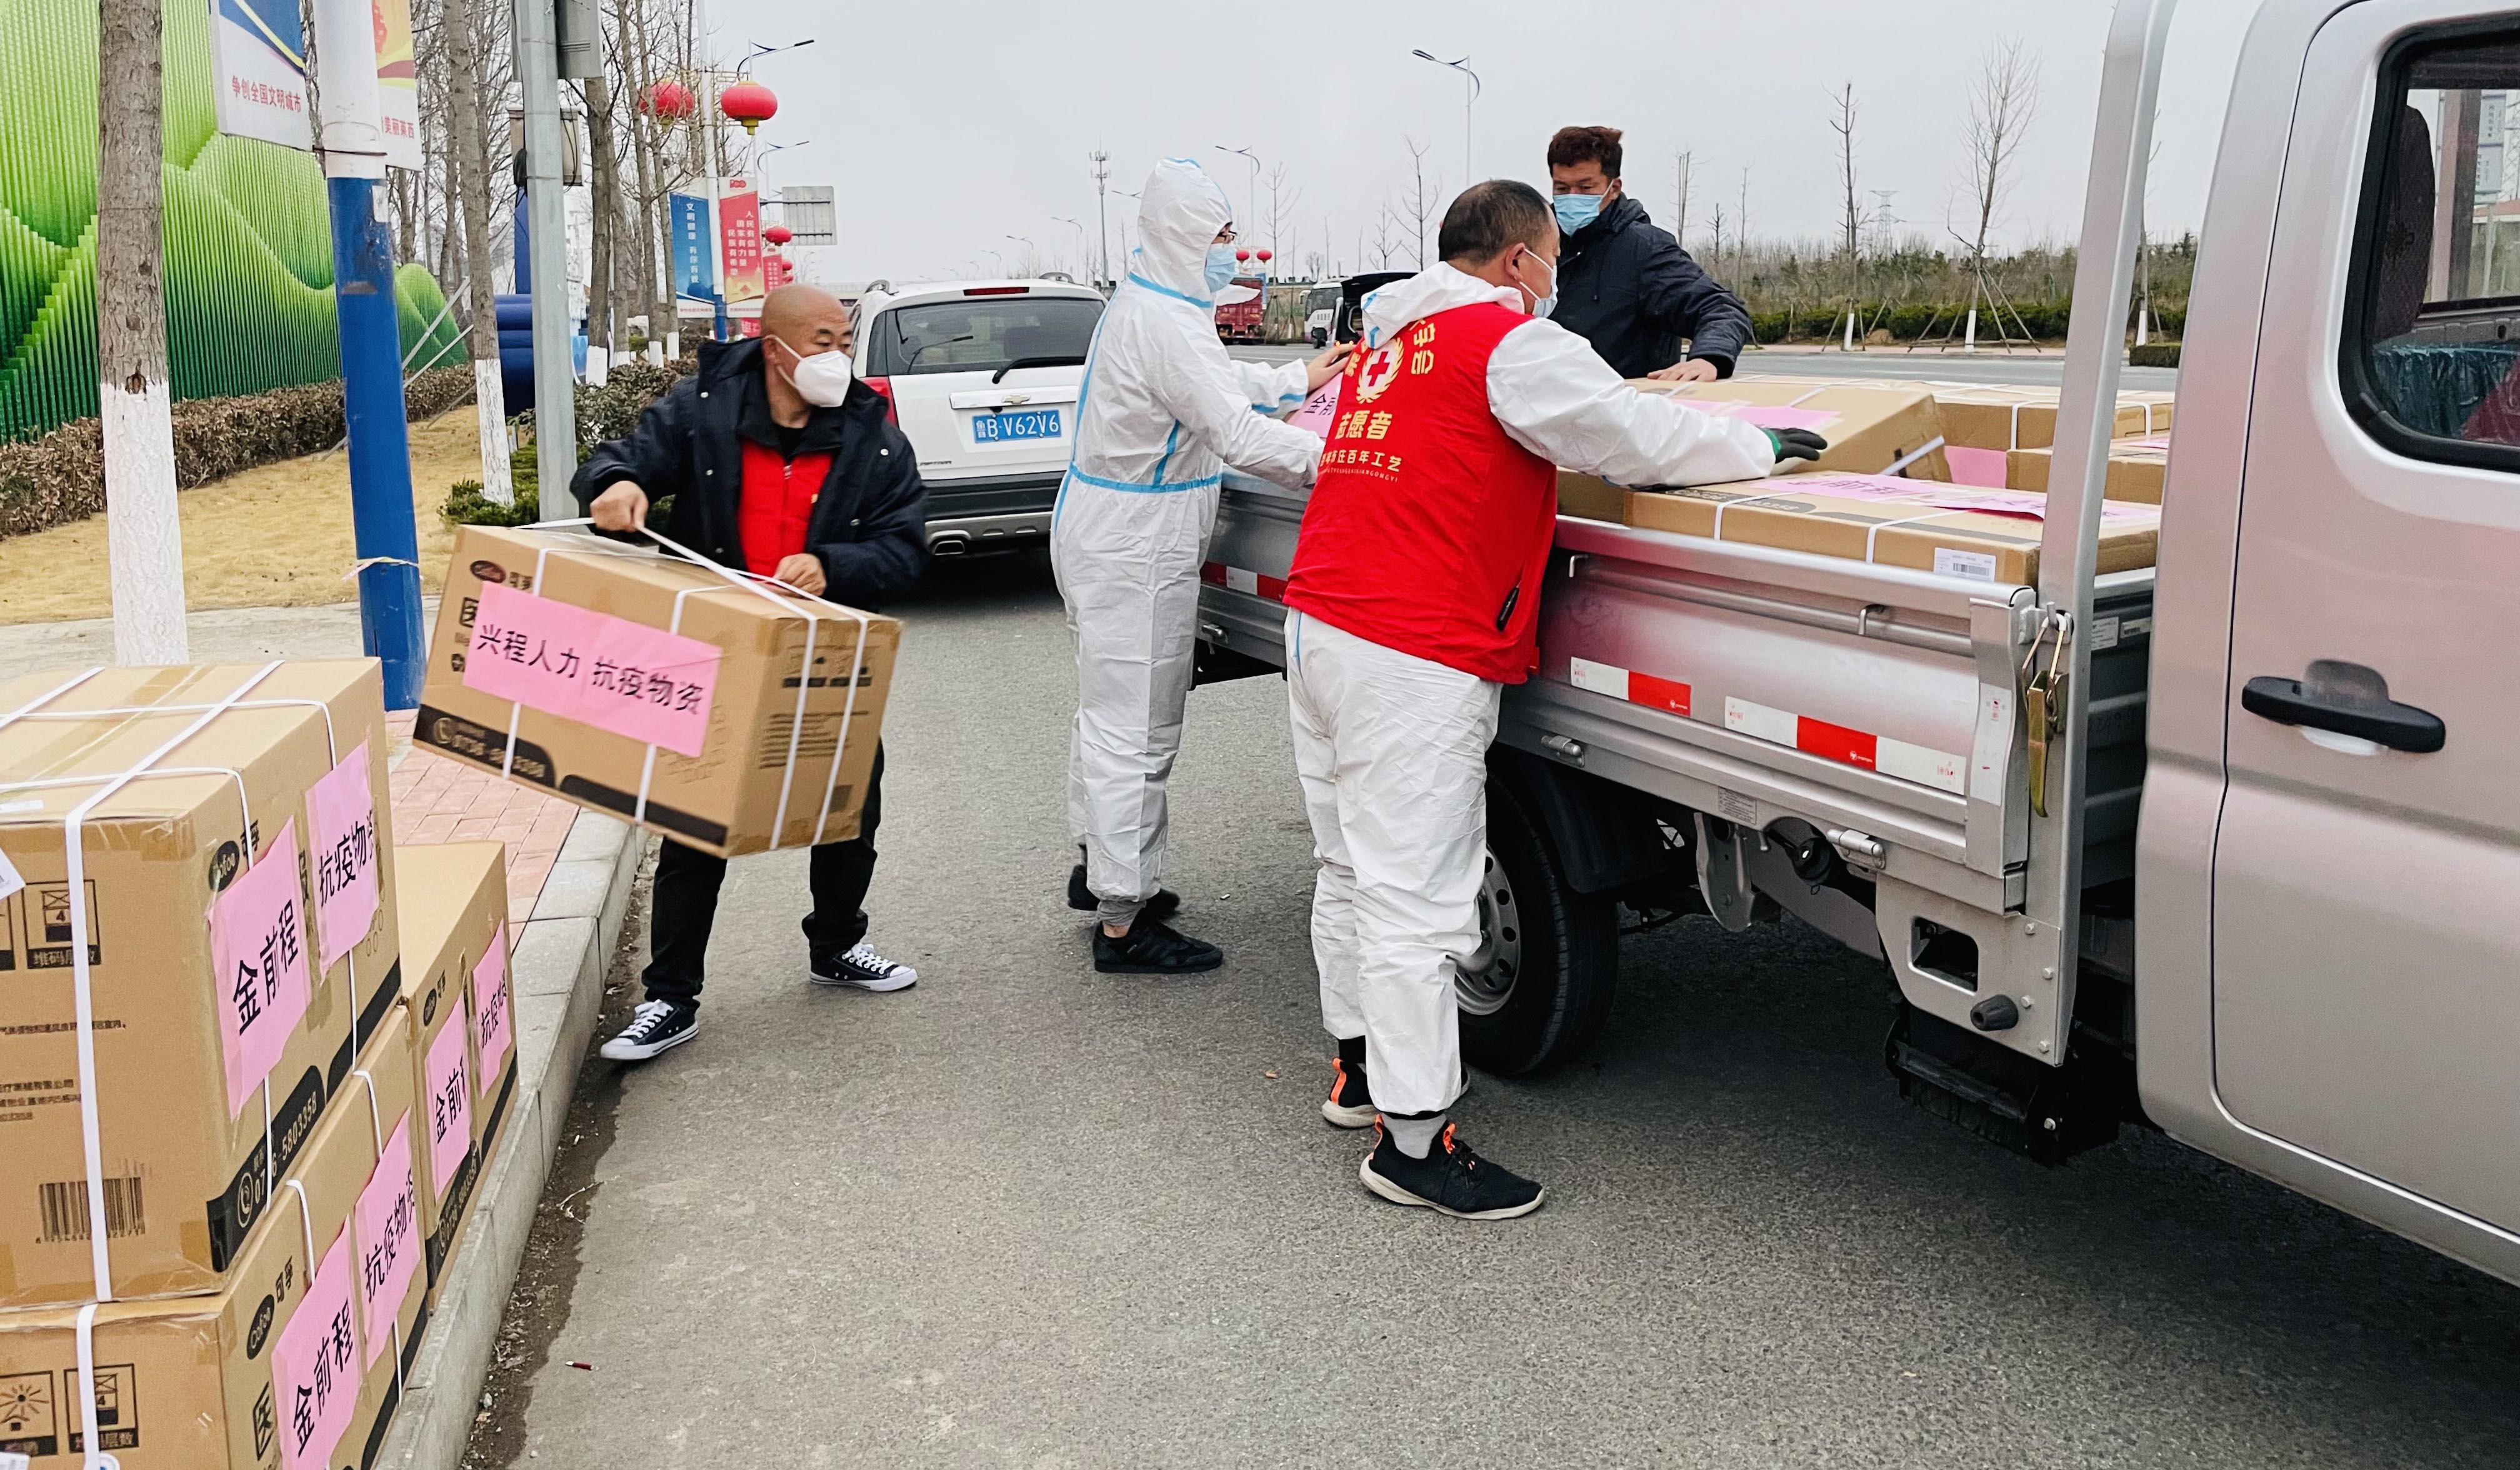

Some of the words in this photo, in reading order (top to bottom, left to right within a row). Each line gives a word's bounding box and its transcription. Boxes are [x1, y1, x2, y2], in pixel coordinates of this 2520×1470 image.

[232, 74, 301, 113] 争创全国文明城市
[1335, 410, 1392, 440] 志愿者
[477, 624, 580, 678] 兴程人力
[592, 656, 704, 714] 抗疫物资
[233, 899, 299, 1036] 金前程
[293, 1296, 353, 1458] 金前程
